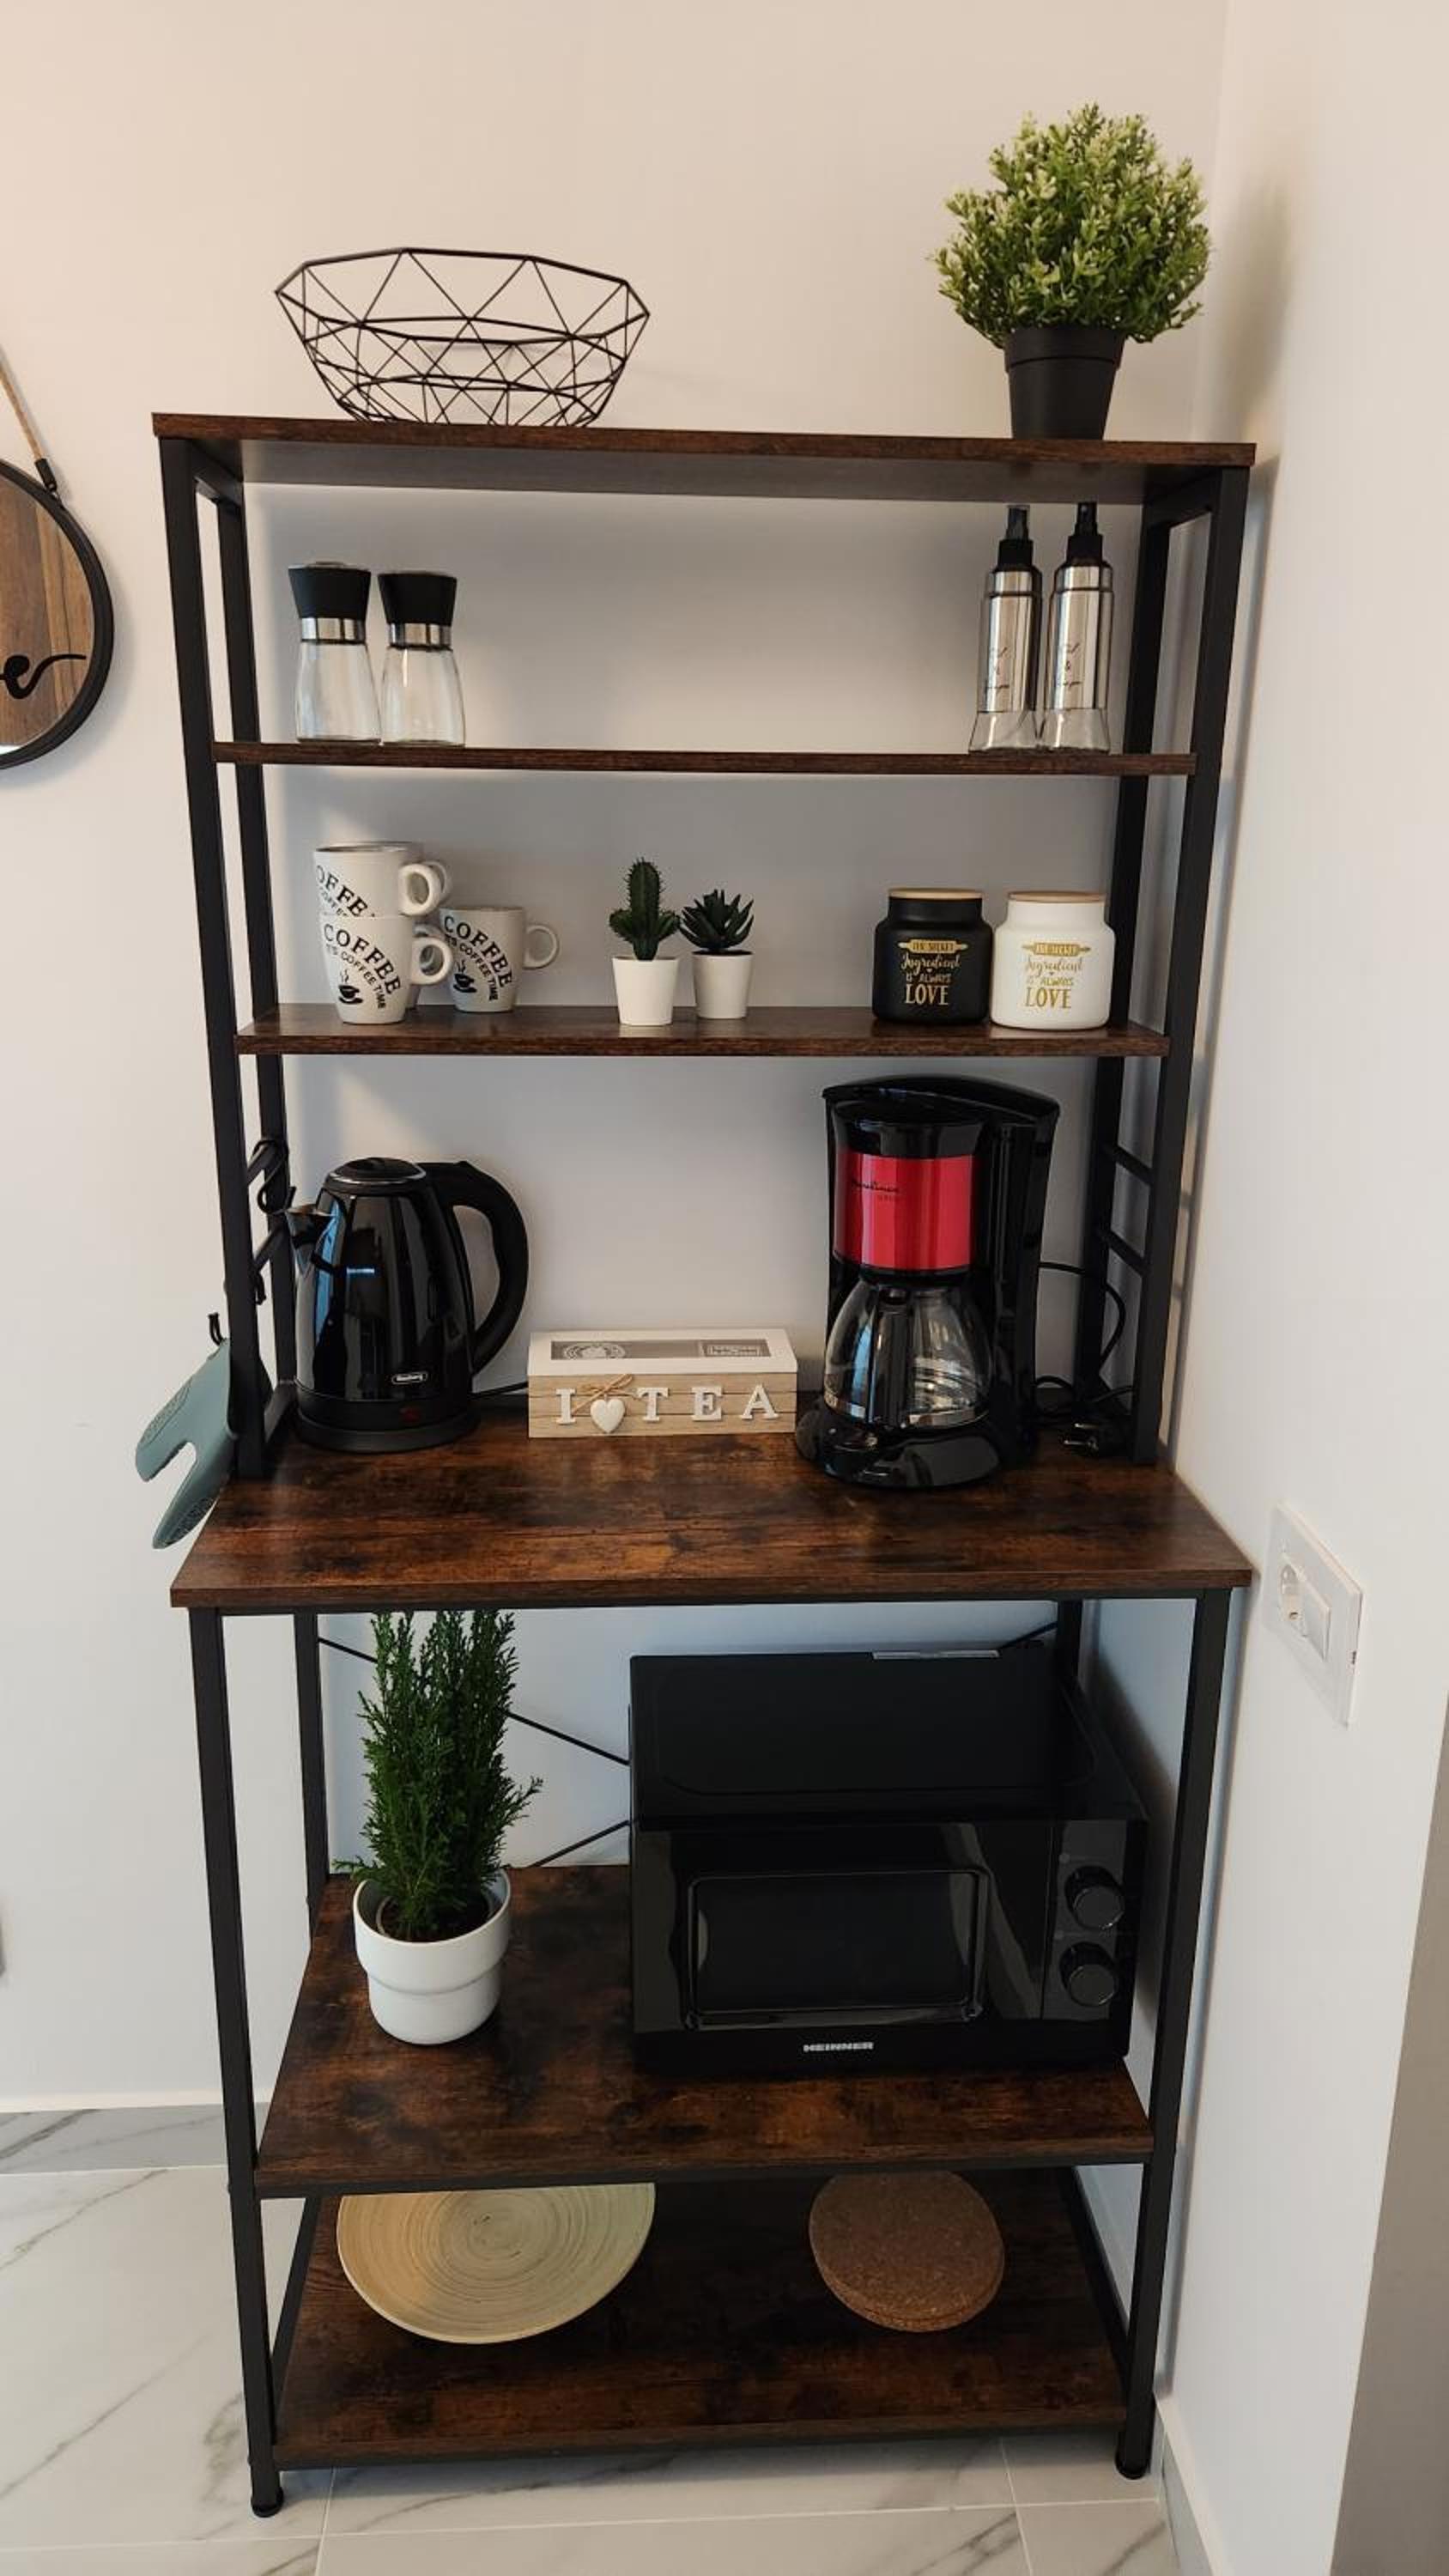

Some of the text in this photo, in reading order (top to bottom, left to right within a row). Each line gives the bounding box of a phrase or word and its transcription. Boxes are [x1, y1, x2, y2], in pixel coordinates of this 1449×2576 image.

[317, 865, 375, 917] OFFE
[324, 924, 401, 994] COFFEE
[341, 951, 378, 986] COFFEE
[445, 915, 512, 987] COFFEE
[459, 943, 492, 977] COFFEE
[901, 952, 961, 975] Ingredient
[905, 983, 949, 1005] LOVE
[1025, 987, 1072, 1008] LOVE
[556, 1388, 576, 1425] I
